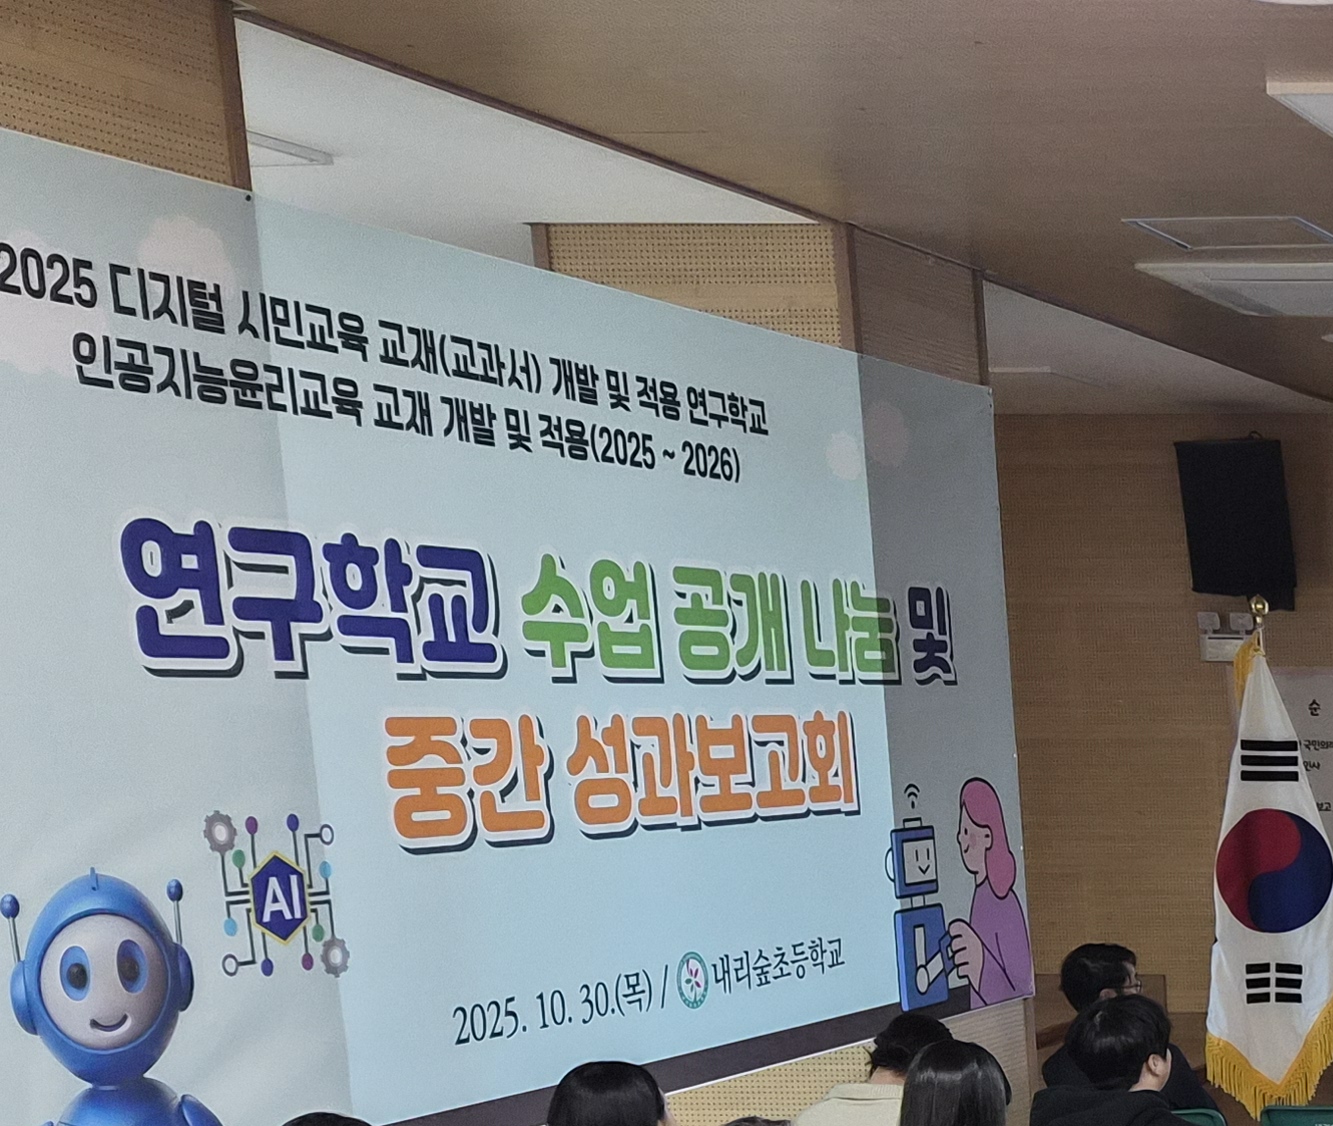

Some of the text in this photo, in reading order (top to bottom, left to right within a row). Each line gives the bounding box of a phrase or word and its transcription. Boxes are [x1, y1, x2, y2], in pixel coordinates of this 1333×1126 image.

[0, 243, 768, 435] 2025 디지털 시민교육 교재(교과서) 개발 및 적용 연구학교
[73, 329, 740, 483] 인공지능윤리교육 교재 개발 및 적용(2025 ~ 2026)
[119, 514, 954, 682] 연구학교 수업 공개 나눔 및
[1308, 699, 1321, 716] 순
[385, 710, 856, 840] 중간 성과보고회
[262, 875, 304, 922] AI
[453, 937, 845, 1045] 2025. 10. 30.(목) / 내리숲초등학교
